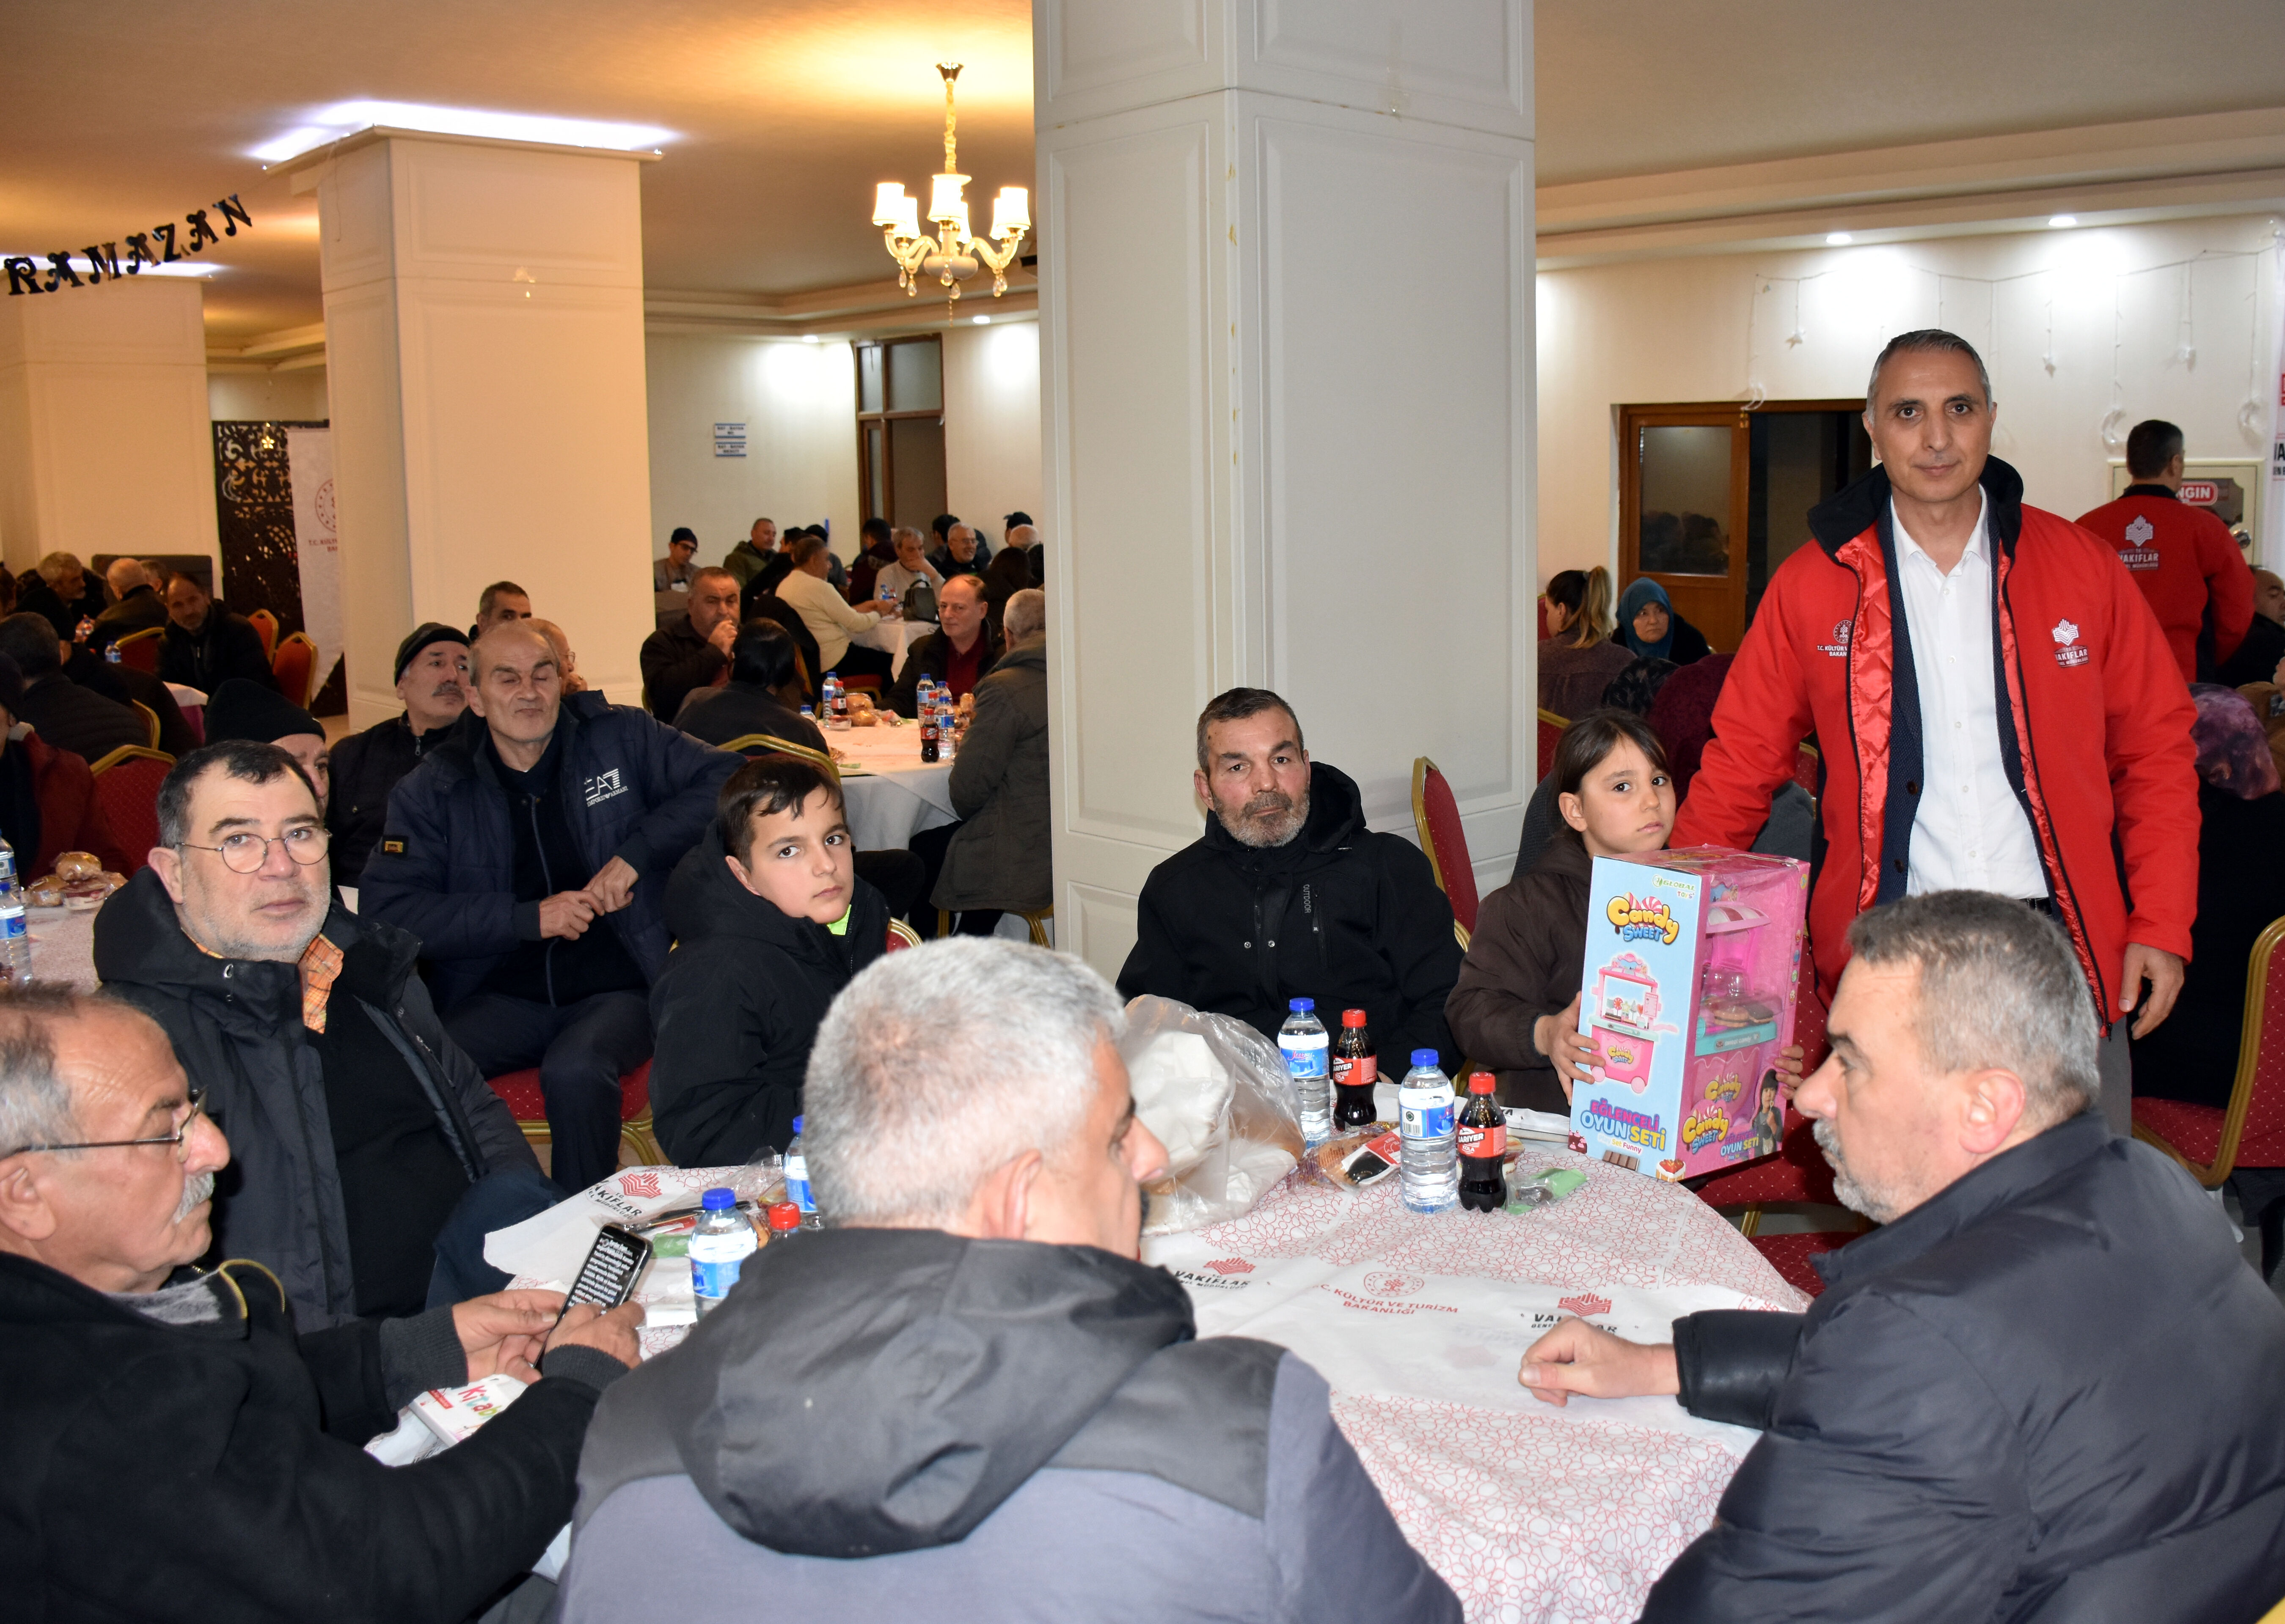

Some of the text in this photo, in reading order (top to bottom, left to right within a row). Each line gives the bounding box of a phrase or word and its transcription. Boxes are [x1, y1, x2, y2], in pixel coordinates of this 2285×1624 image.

[3, 193, 253, 295] RAMAZAN
[2176, 486, 2211, 499] NGIN
[611, 786, 628, 797] ARMANI
[1663, 880, 1695, 890] GLOBAL
[1303, 884, 1311, 913] OUTDOOR
[1607, 896, 1679, 945] Candy
[1623, 925, 1663, 942] SWEET
[1333, 1063, 1352, 1072] ARIYER
[1590, 1097, 1660, 1132] EĞLENCELİ
[1580, 1110, 1666, 1151] OYUN SETİ
[1682, 1107, 1729, 1145] Candy
[1623, 1142, 1642, 1154] Funny
[1692, 1129, 1719, 1155] SWEET
[1721, 1141, 1743, 1157] OYUN
[1334, 1289, 1384, 1306] KÜLTÜR
[1409, 1303, 1458, 1313] TURİZM
[1343, 1301, 1415, 1314] BAKANLIĞI
